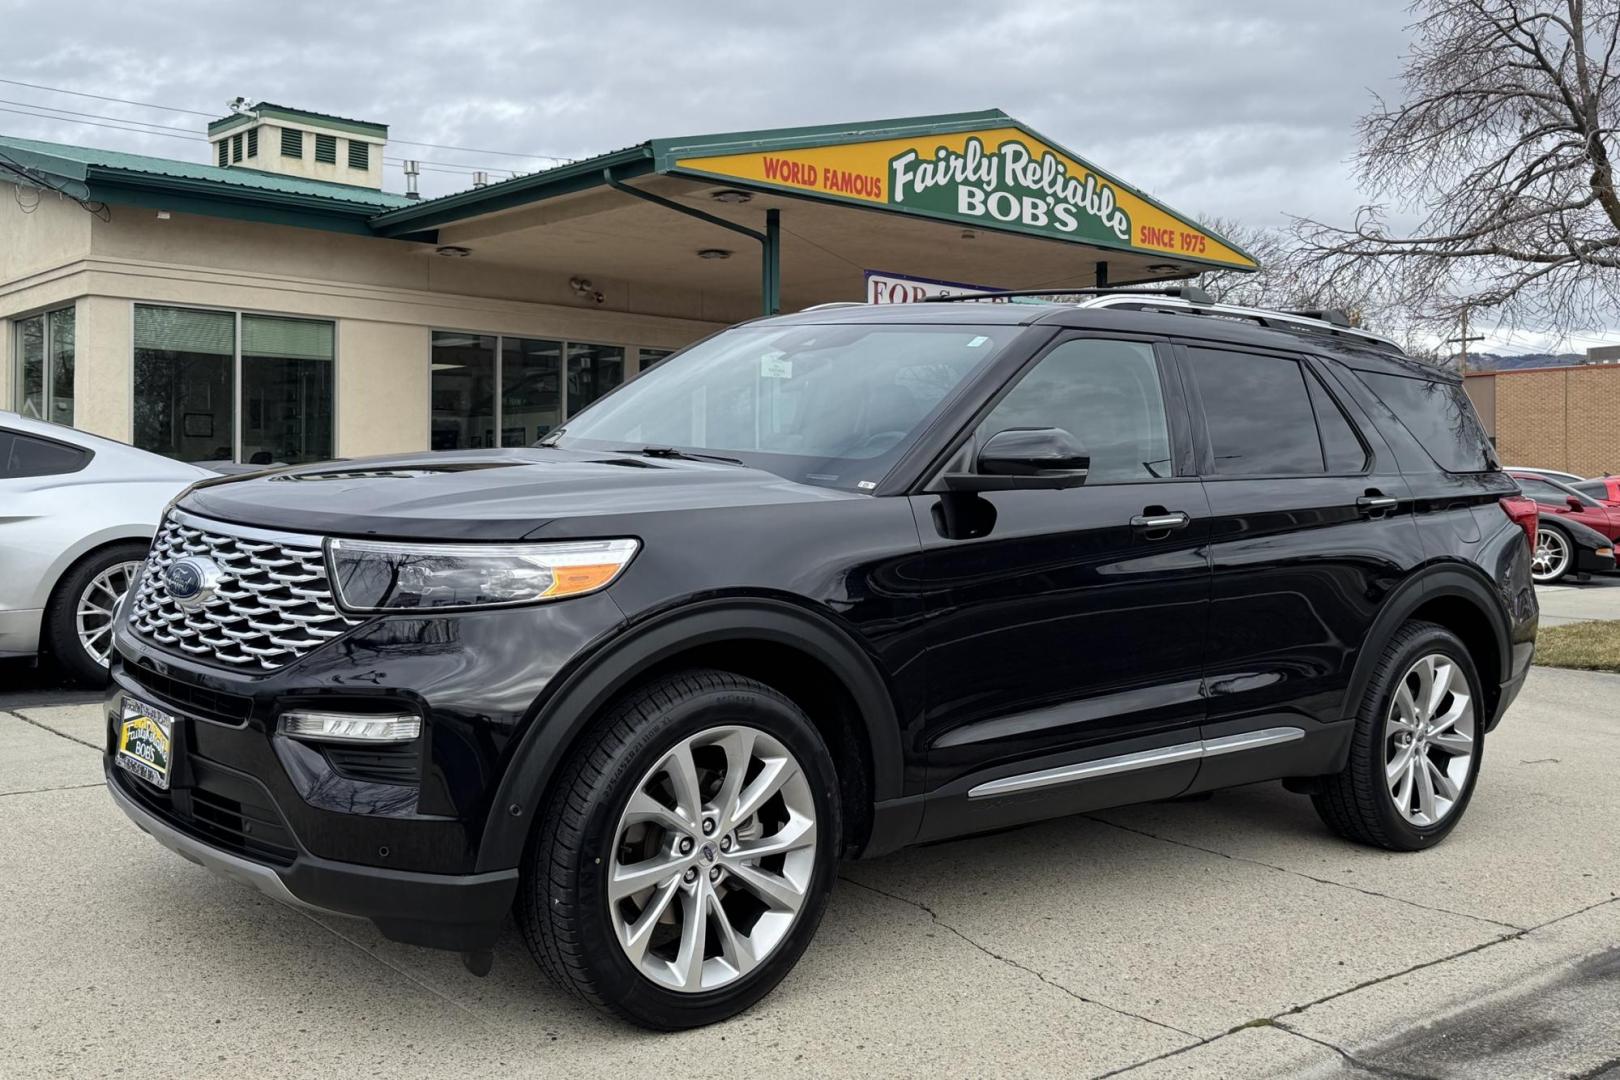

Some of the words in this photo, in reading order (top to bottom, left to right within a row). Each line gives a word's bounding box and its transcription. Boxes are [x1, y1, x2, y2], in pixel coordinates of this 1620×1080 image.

[763, 156, 818, 187] WORLD
[823, 168, 882, 199] FAMOUS
[892, 140, 999, 203] Fairly
[1001, 142, 1129, 240] Reliable
[957, 184, 1079, 232] BOB'S
[1140, 225, 1176, 249] SINCE
[1180, 231, 1207, 254] 1975
[135, 740, 155, 762] BOB'S
